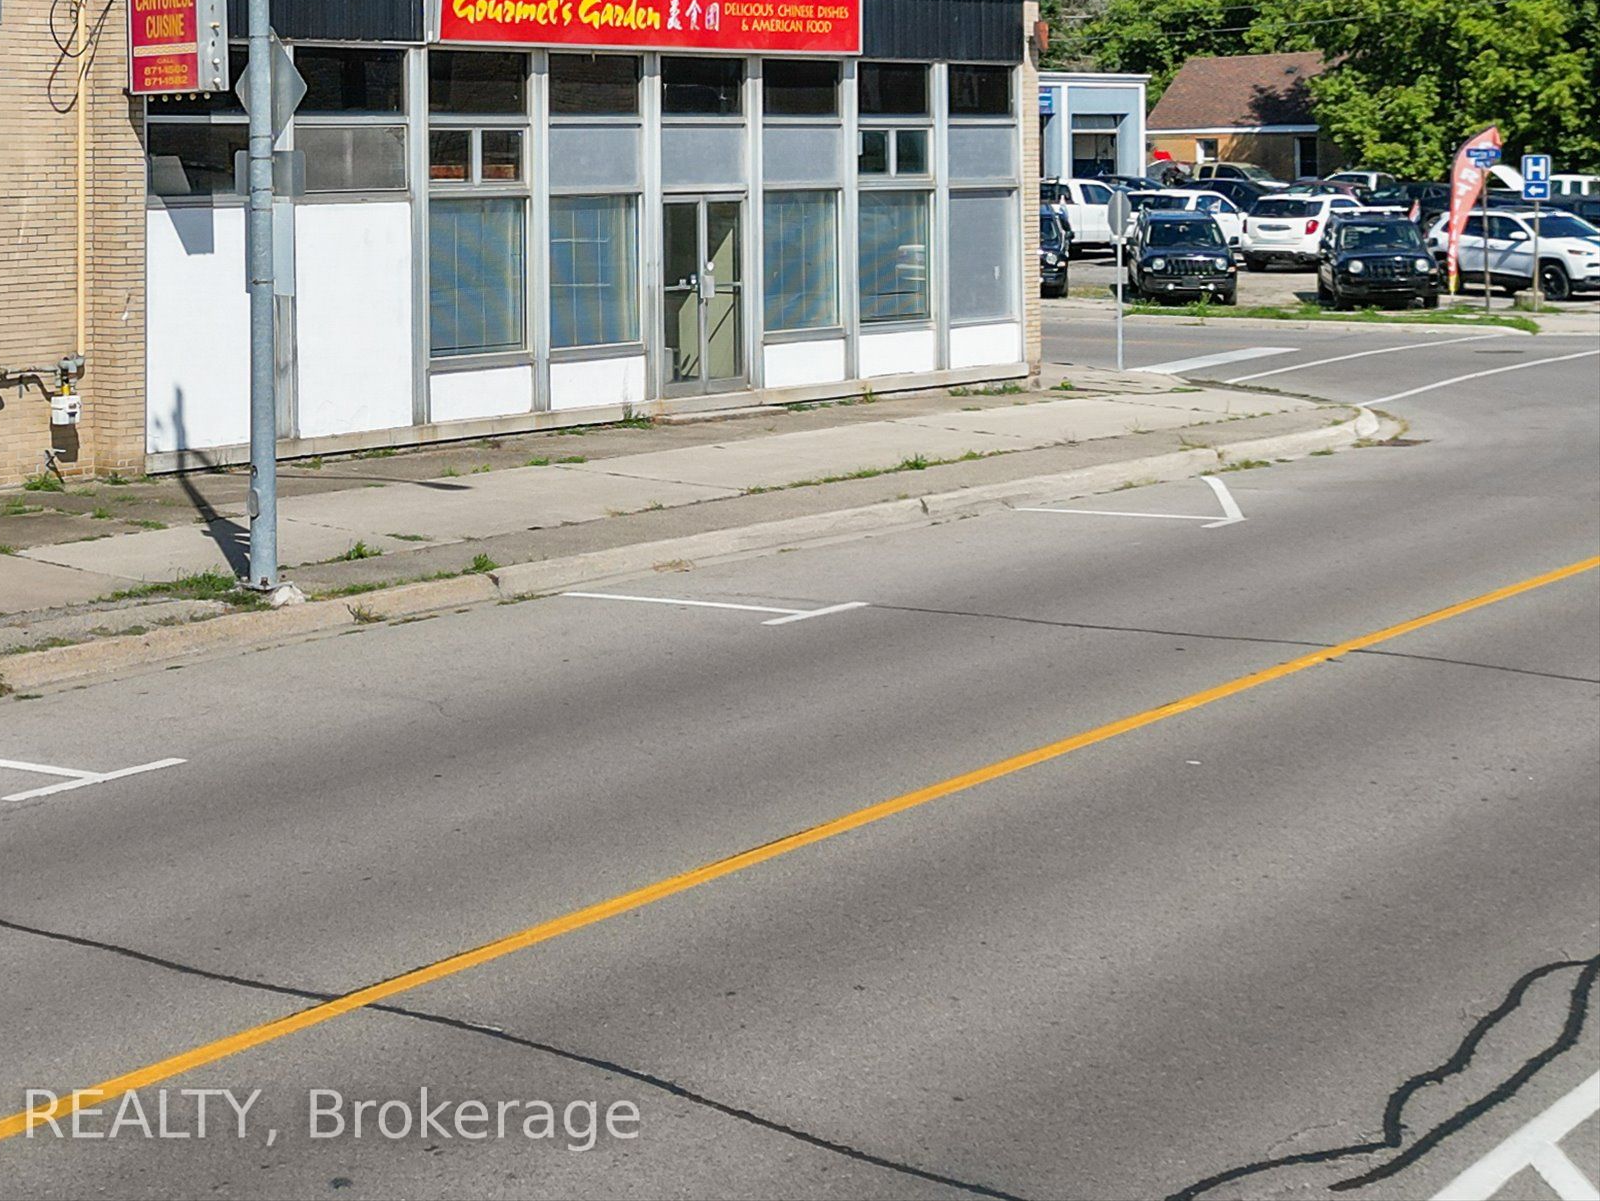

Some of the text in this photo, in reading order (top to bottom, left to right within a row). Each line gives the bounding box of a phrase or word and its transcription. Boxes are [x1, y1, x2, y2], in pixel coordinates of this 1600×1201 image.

[724, 2, 849, 19] DELICIOUS CHINESE DISHES
[146, 13, 185, 39] CUISINE
[741, 19, 832, 33] & AMERICAN FOOD
[1526, 158, 1546, 180] H
